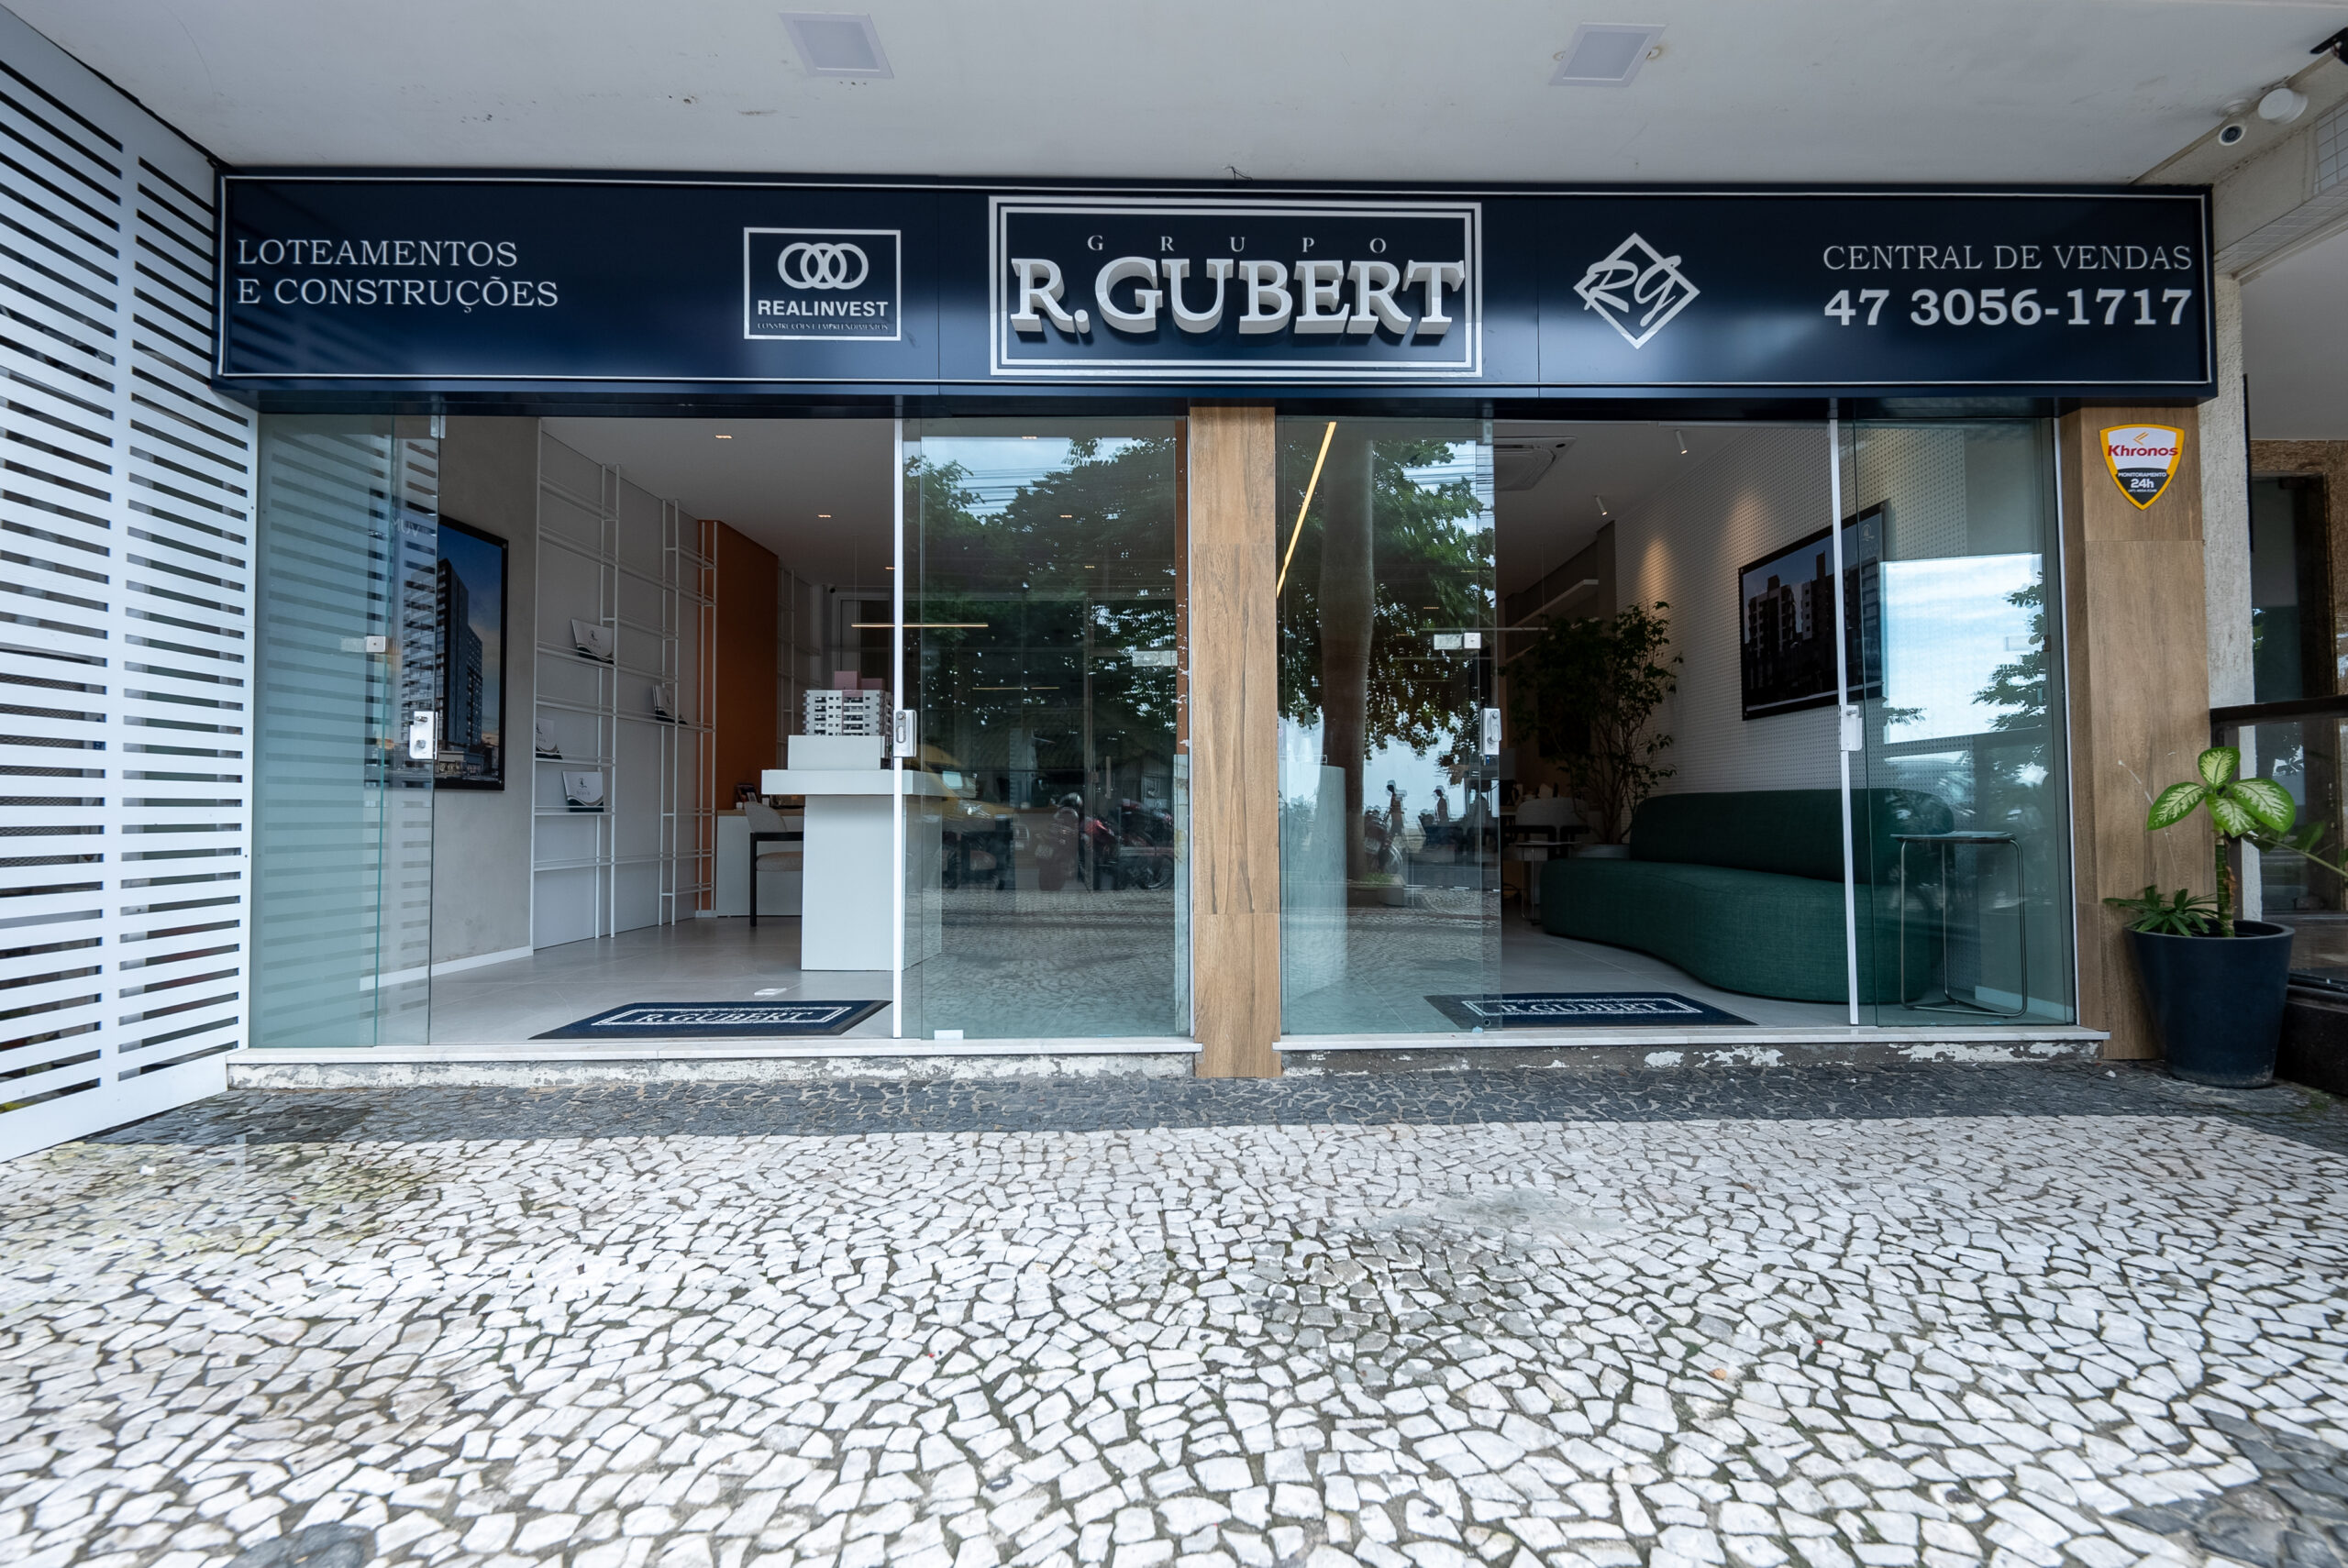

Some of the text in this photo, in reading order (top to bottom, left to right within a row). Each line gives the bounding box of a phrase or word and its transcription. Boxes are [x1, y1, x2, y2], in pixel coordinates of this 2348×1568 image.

[238, 238, 517, 268] LOTEAMENTOS
[1087, 235, 1387, 253] GRUPO
[1823, 244, 2193, 271] CENTRAL DE VENDAS
[238, 276, 559, 314] E CONSTRUÇÕES
[758, 300, 889, 316] REALINVEST
[1823, 288, 2192, 326] 47 3056-1717
[2108, 445, 2178, 457] Khronos
[2131, 478, 2154, 488] 24h
